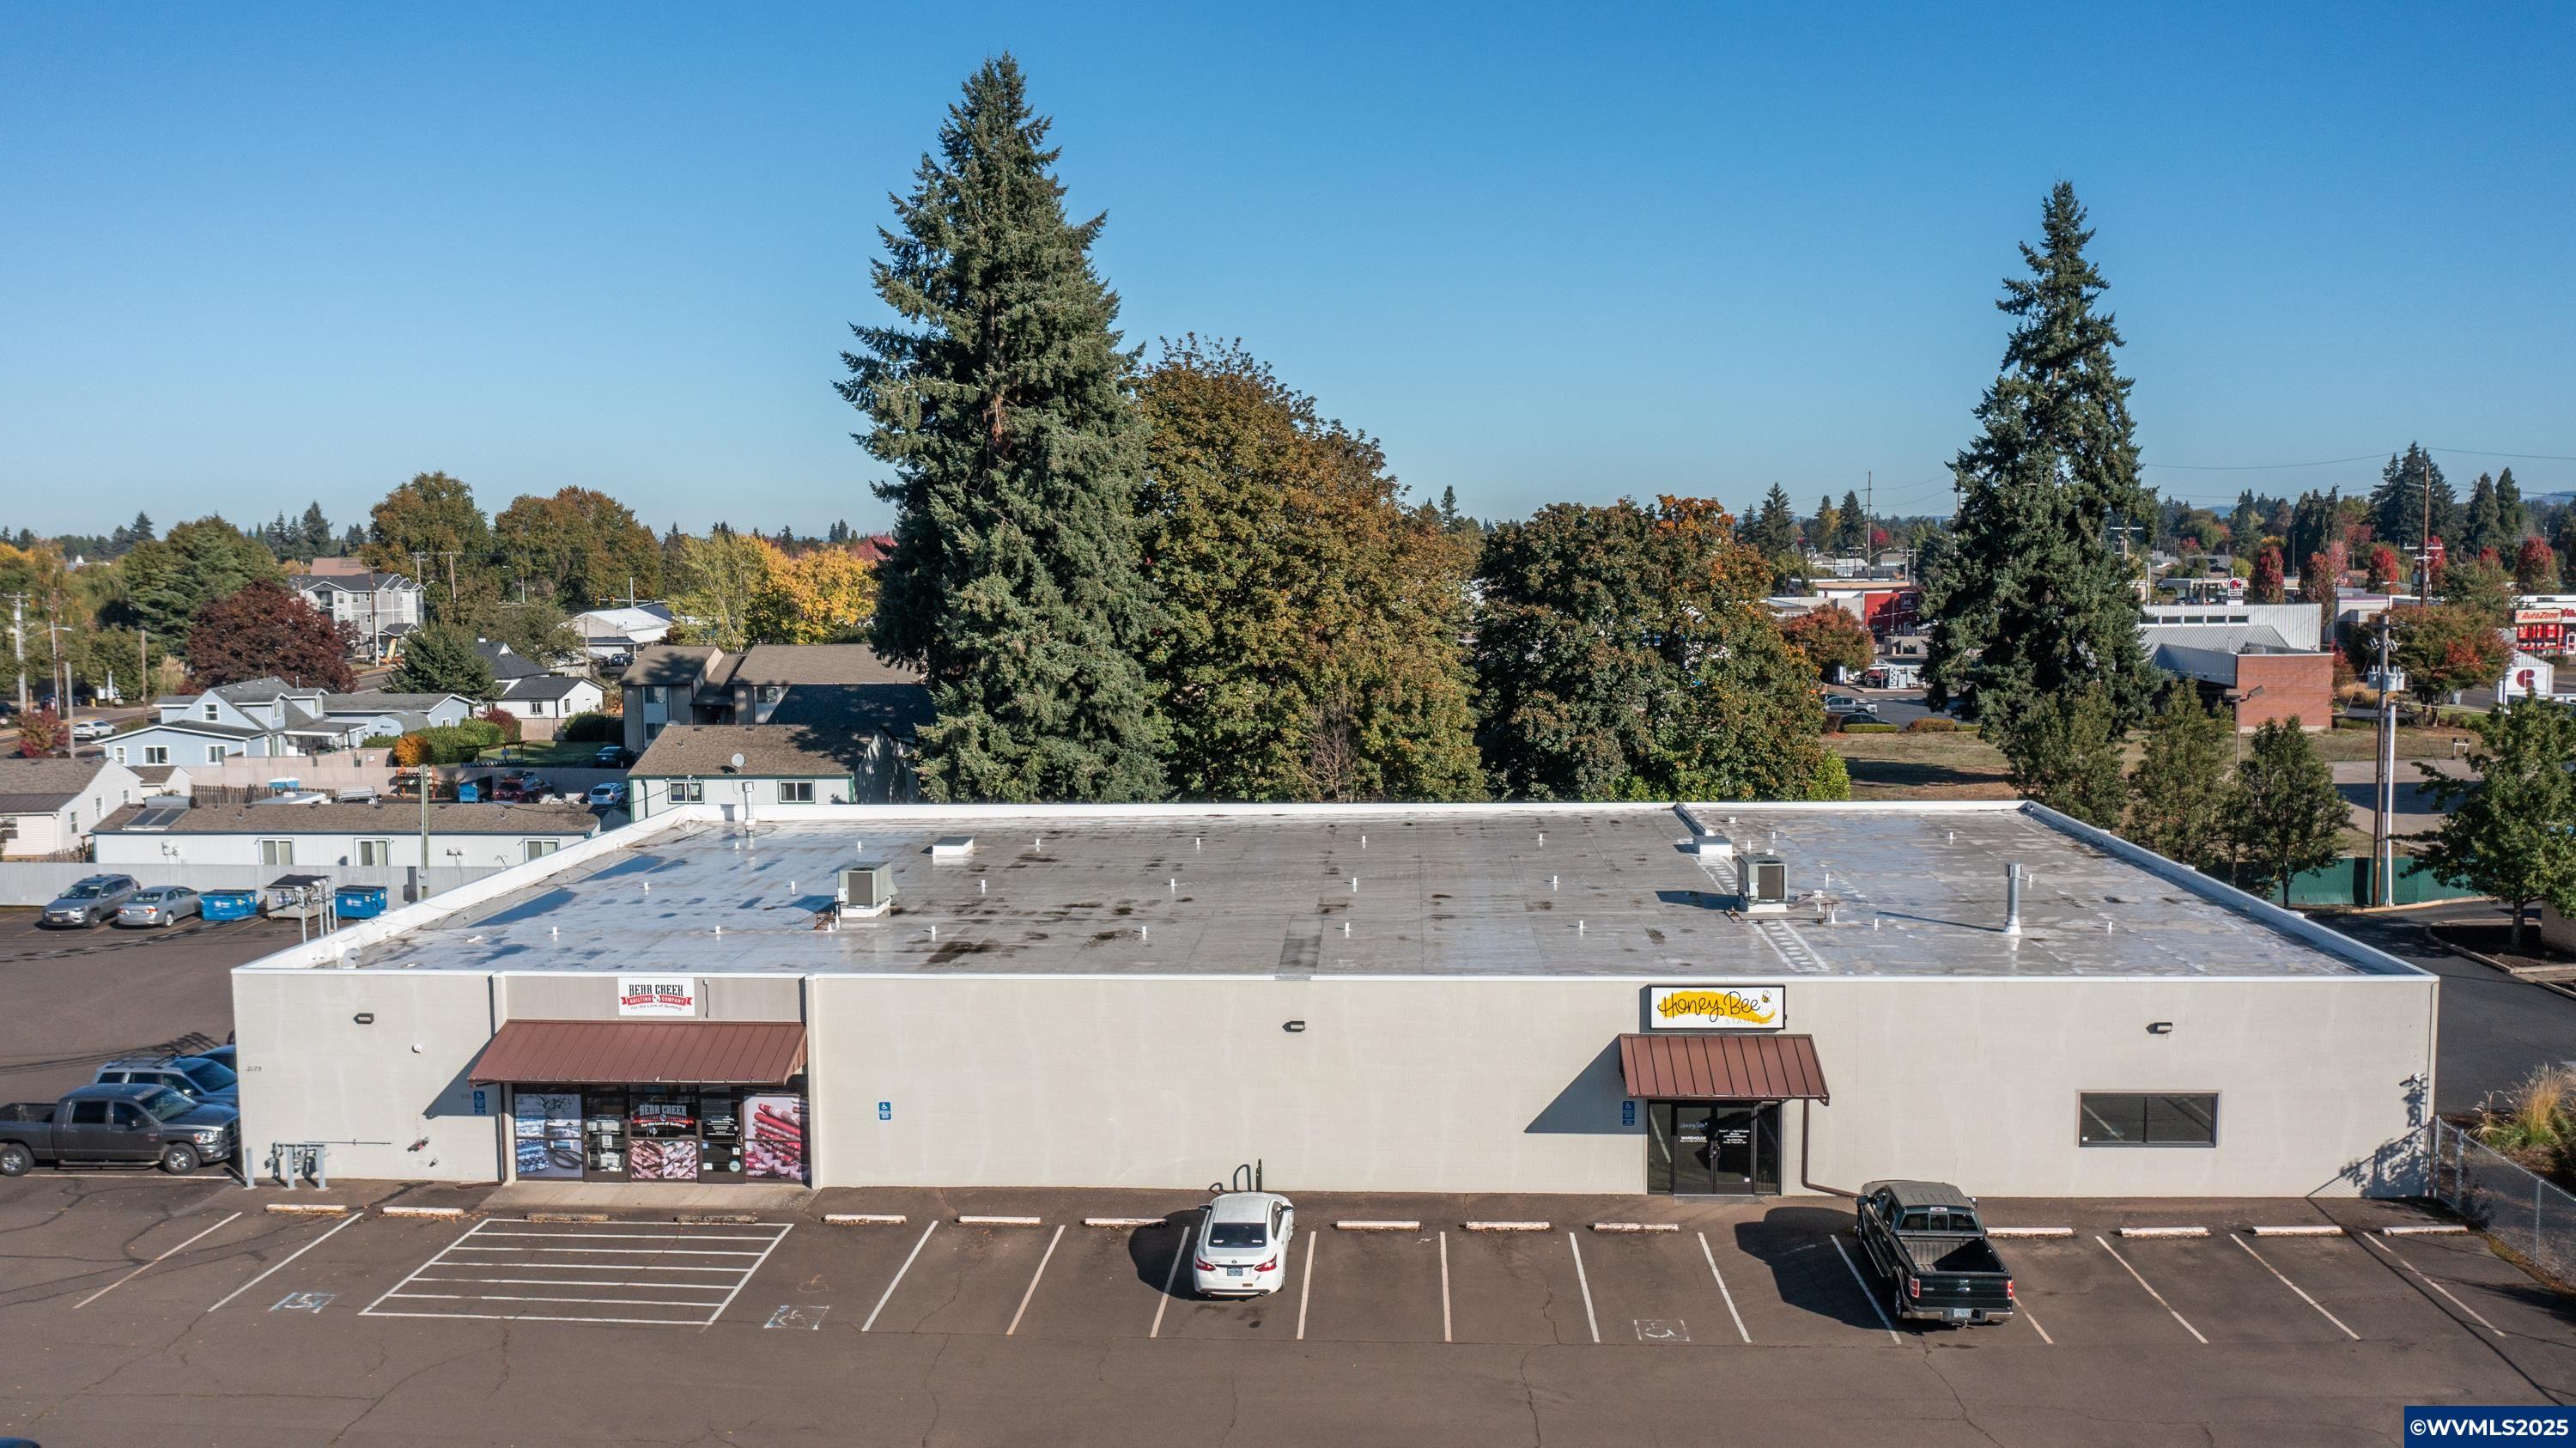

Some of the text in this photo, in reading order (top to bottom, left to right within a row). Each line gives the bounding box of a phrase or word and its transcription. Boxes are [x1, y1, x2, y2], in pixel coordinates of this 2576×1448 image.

[629, 984, 683, 996] BEAR CREEK
[1657, 991, 1761, 1022] Honey Bee
